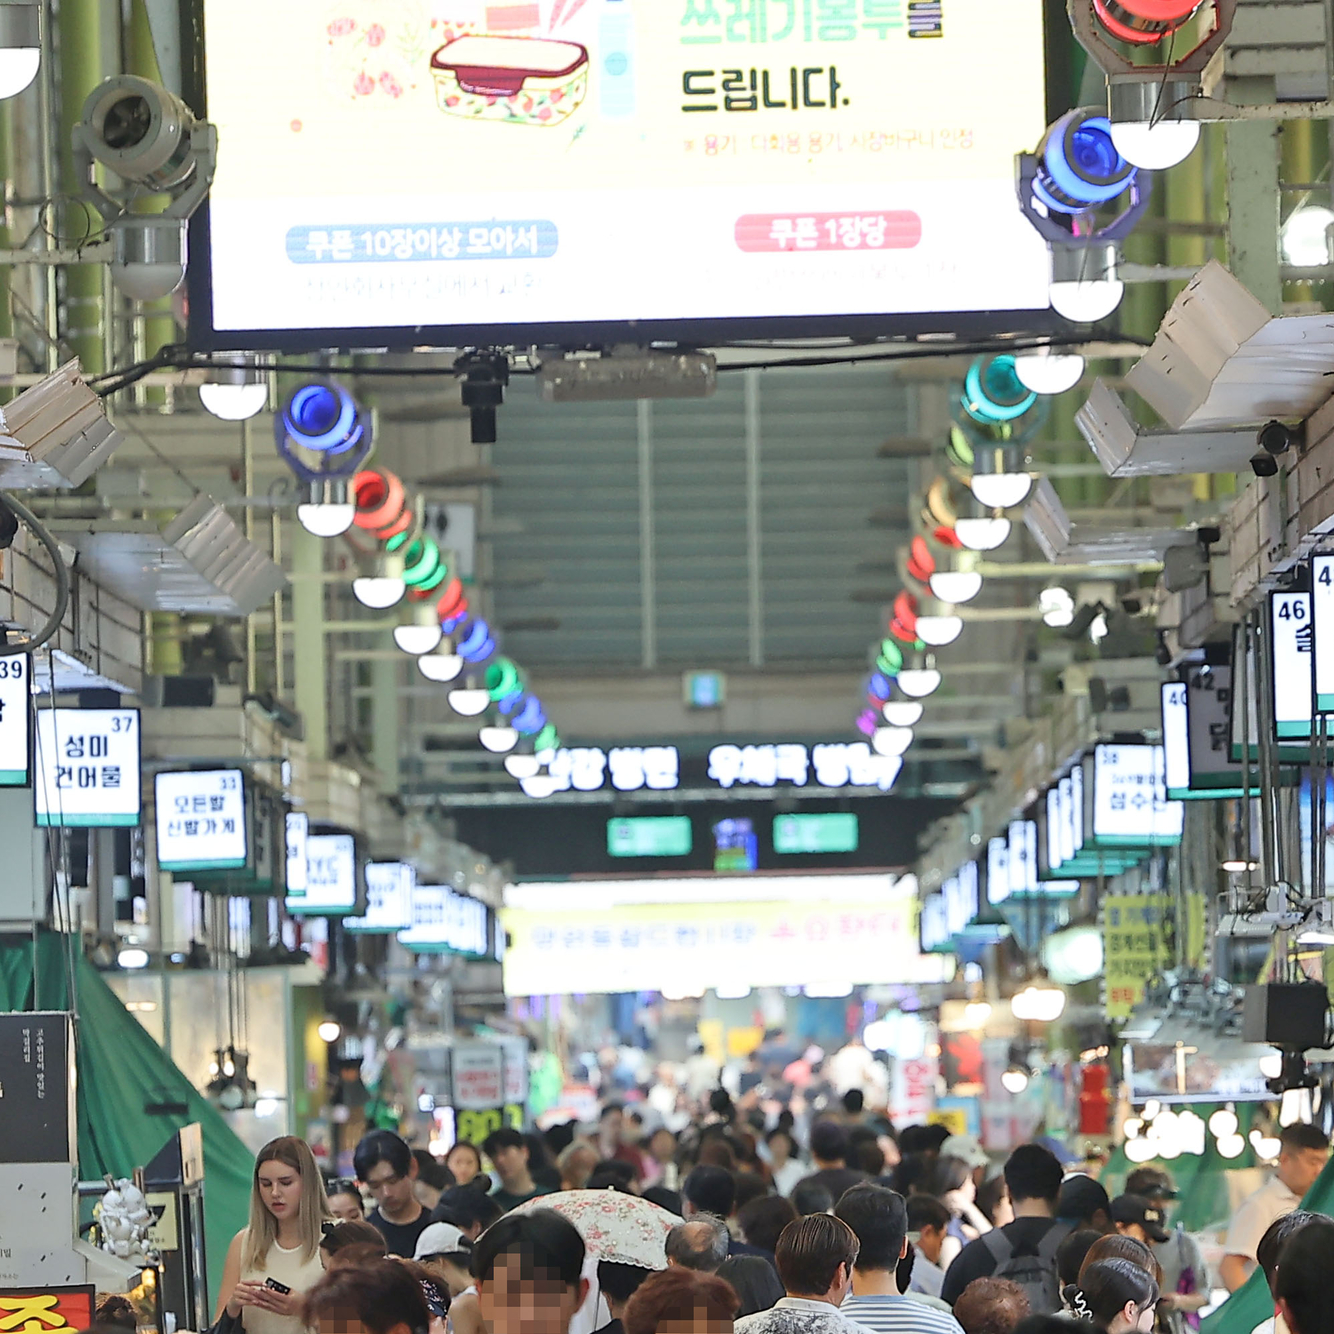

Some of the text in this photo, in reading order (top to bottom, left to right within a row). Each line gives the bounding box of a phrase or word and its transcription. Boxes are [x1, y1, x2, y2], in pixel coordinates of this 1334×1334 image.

[681, 66, 850, 112] 드립니다.
[305, 223, 538, 261] 쿠폰 10장이상 모아서
[768, 214, 888, 248] 쿠폰 1장당
[1278, 600, 1306, 621] 46
[110, 715, 134, 733] 37
[64, 734, 109, 759] 성미
[55, 765, 122, 790] 건어물
[166, 817, 236, 838] 신발가게
